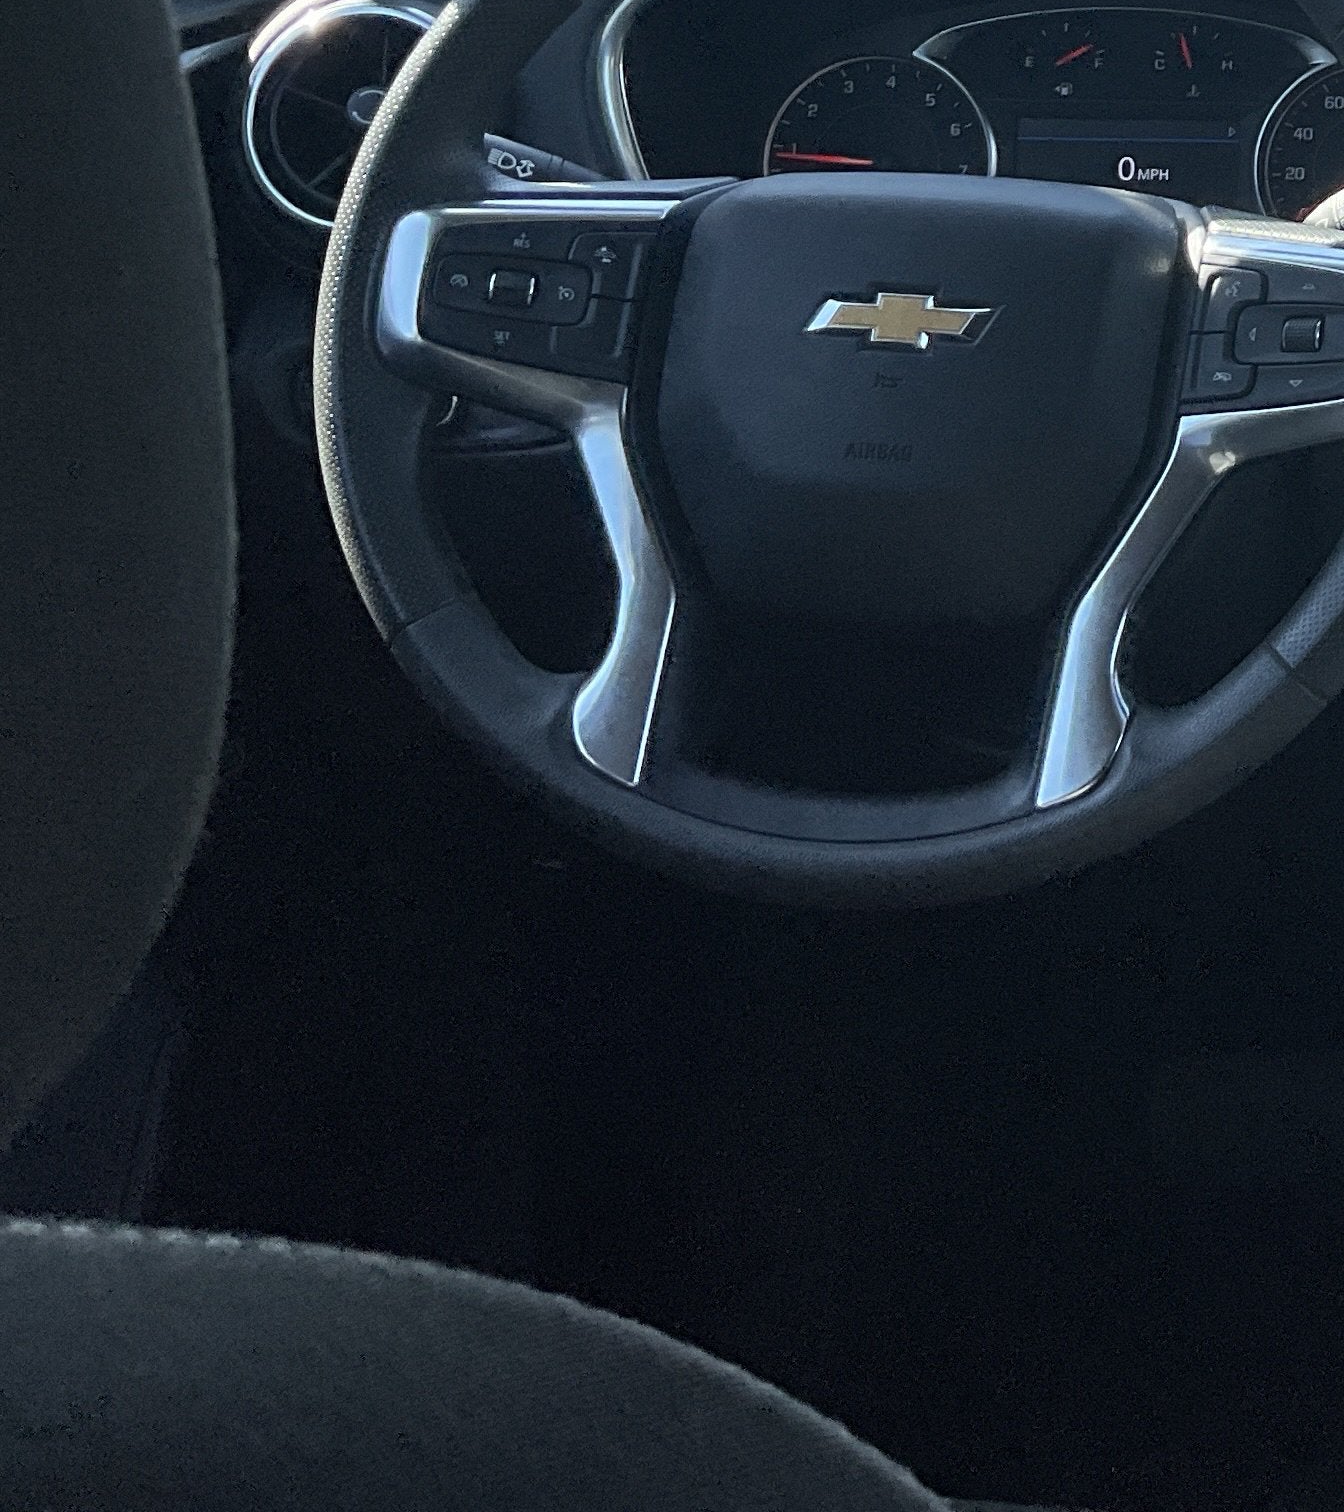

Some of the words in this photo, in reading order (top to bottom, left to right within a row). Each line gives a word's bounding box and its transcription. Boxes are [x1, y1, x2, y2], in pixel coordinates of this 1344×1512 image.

[844, 80, 854, 94] 3
[885, 76, 896, 89] 4
[925, 93, 936, 107] 5
[1324, 96, 1344, 110] 60
[807, 103, 818, 117] 2
[950, 123, 961, 136] 6
[1294, 127, 1314, 140] 40
[1118, 156, 1135, 181] 0
[1137, 168, 1169, 181] MPH
[1285, 167, 1305, 180] 20
